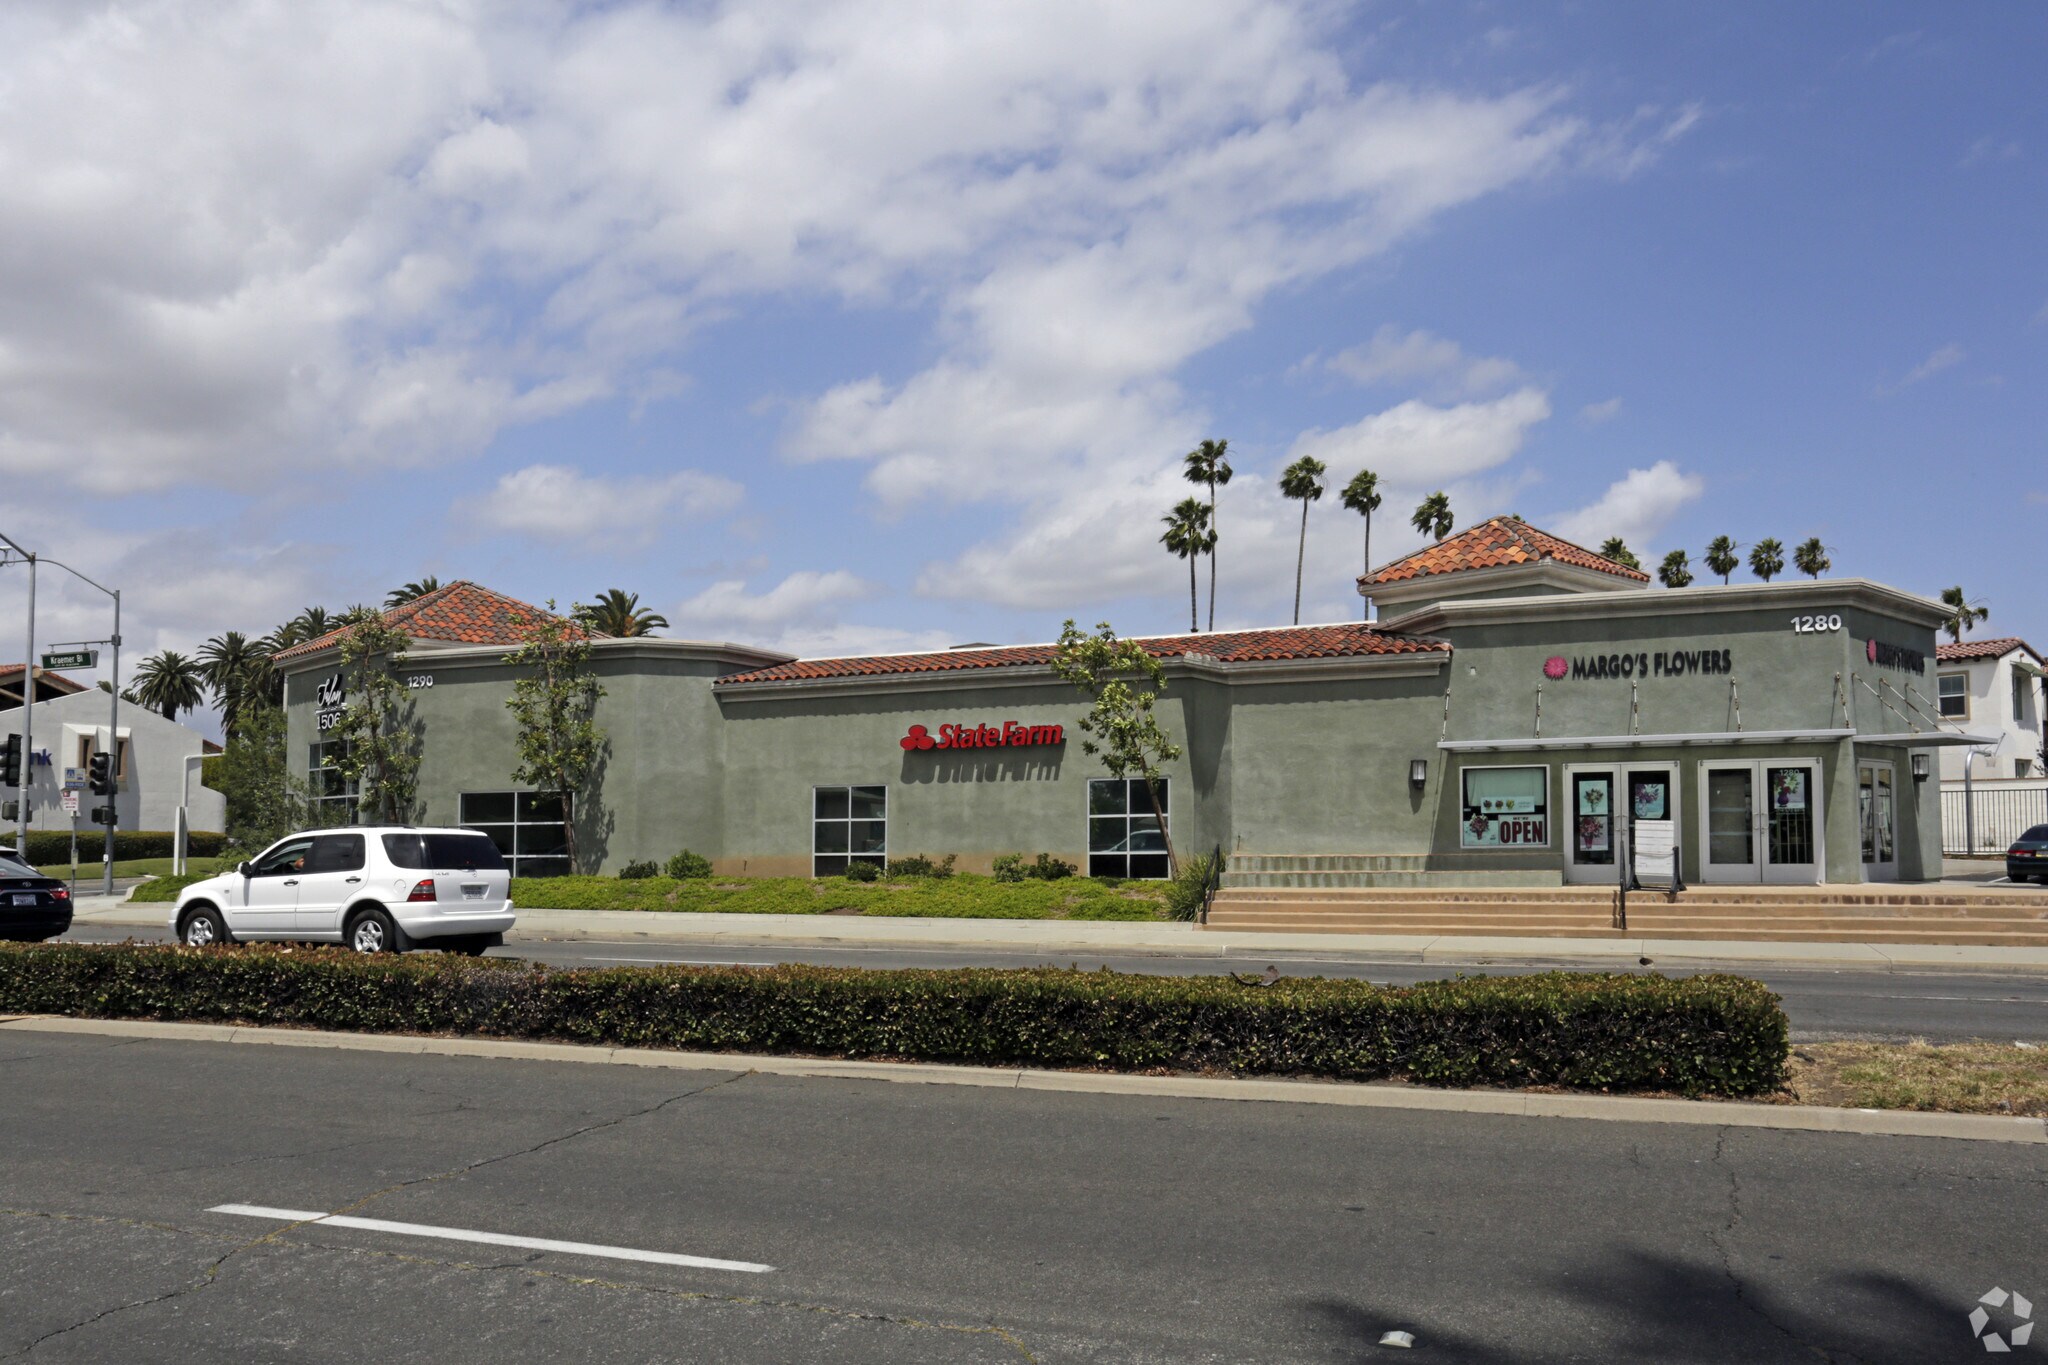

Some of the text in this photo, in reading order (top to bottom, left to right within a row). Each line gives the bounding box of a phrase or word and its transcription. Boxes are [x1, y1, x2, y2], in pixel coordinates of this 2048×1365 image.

[1790, 614, 1842, 632] 1280
[50, 656, 75, 665] Kraemer
[1572, 649, 1732, 679] MARGO'S FLOWERS
[407, 675, 434, 688] 1290
[316, 712, 342, 730] 1506
[1500, 821, 1543, 844] OPEN
